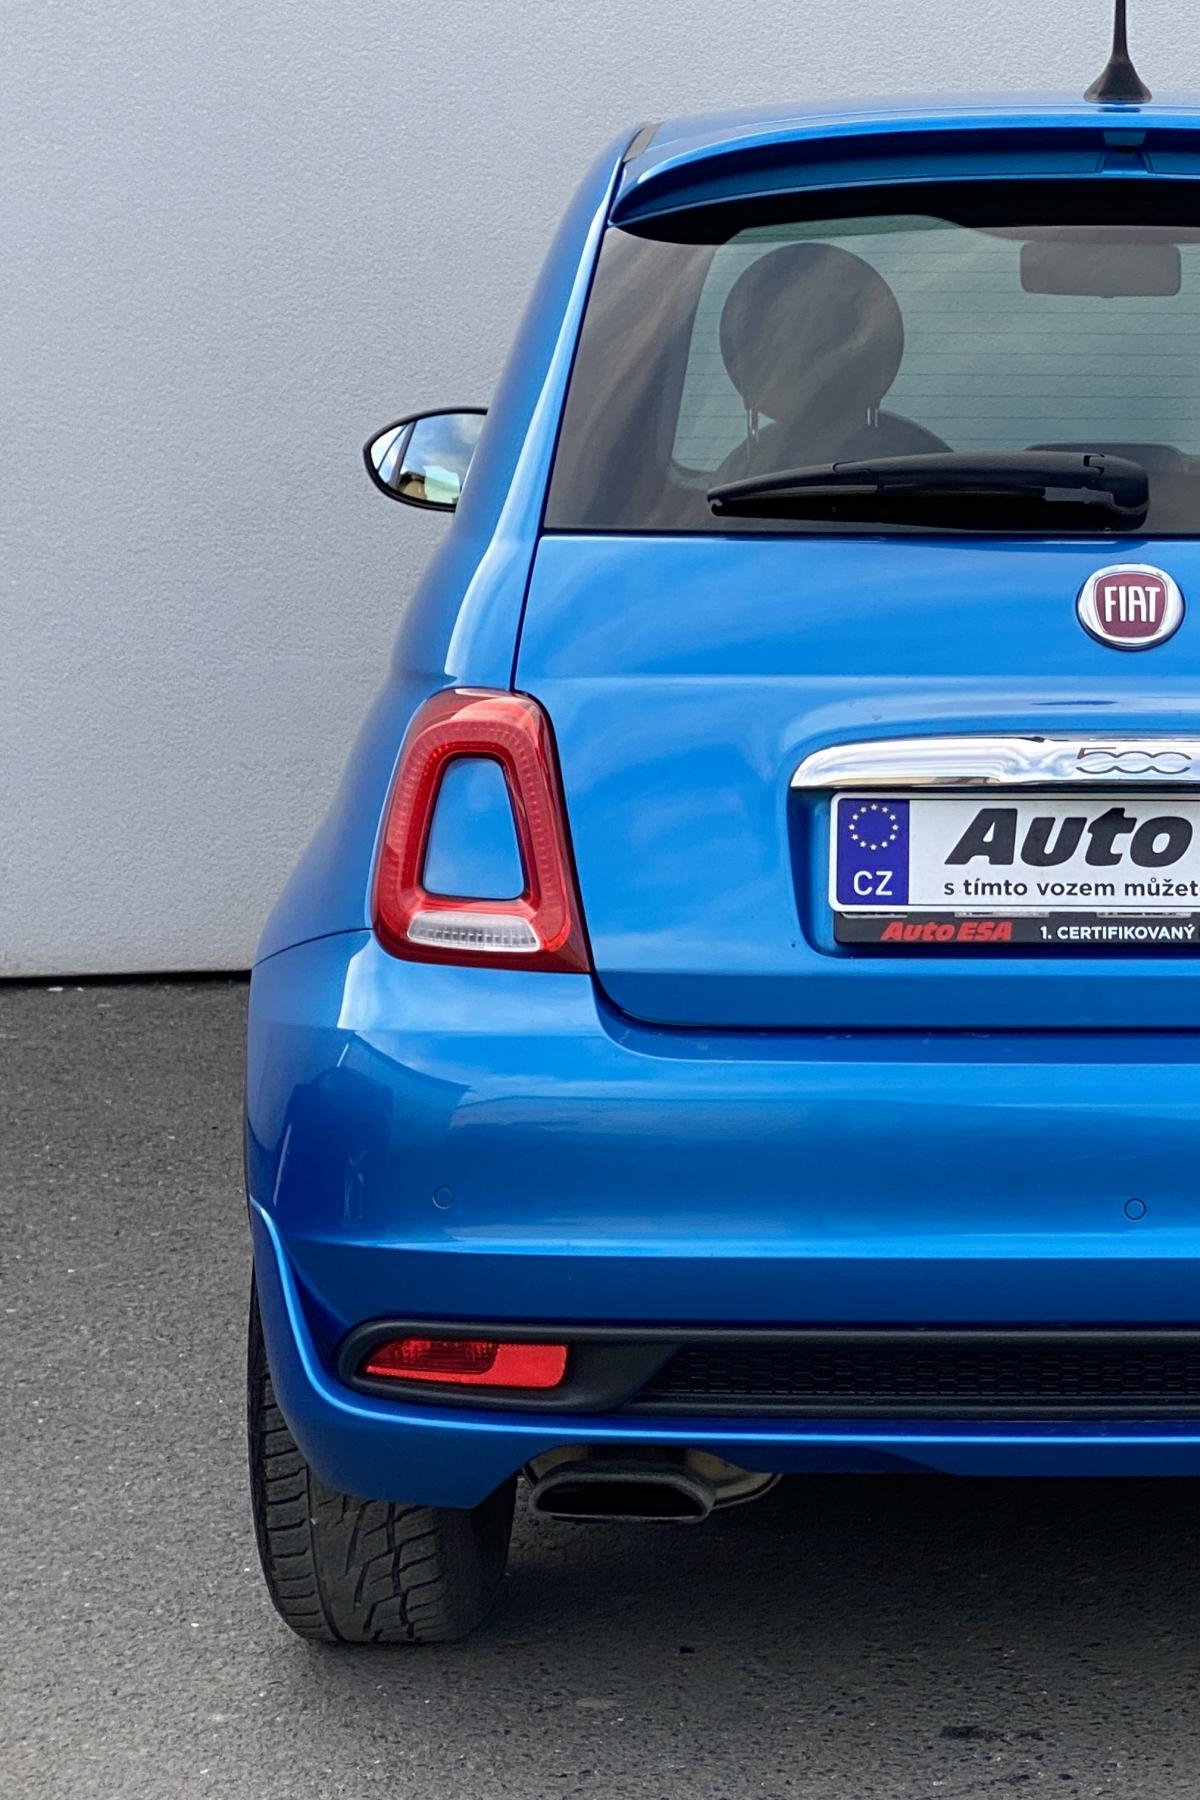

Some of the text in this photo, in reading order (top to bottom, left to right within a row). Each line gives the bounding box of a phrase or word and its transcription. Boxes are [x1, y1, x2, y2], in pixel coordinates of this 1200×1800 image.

[1104, 585, 1161, 623] FIAT
[1076, 746, 1192, 775] 500
[944, 807, 1193, 868] Auto
[852, 870, 893, 896] CZ
[943, 882, 955, 896] s
[963, 877, 1028, 897] tímto
[1037, 882, 1115, 897] vozem
[880, 921, 1013, 942] Auto ESA
[1040, 925, 1052, 940] 1.
[1056, 924, 1196, 941] CERTIFIKOVANÝ
